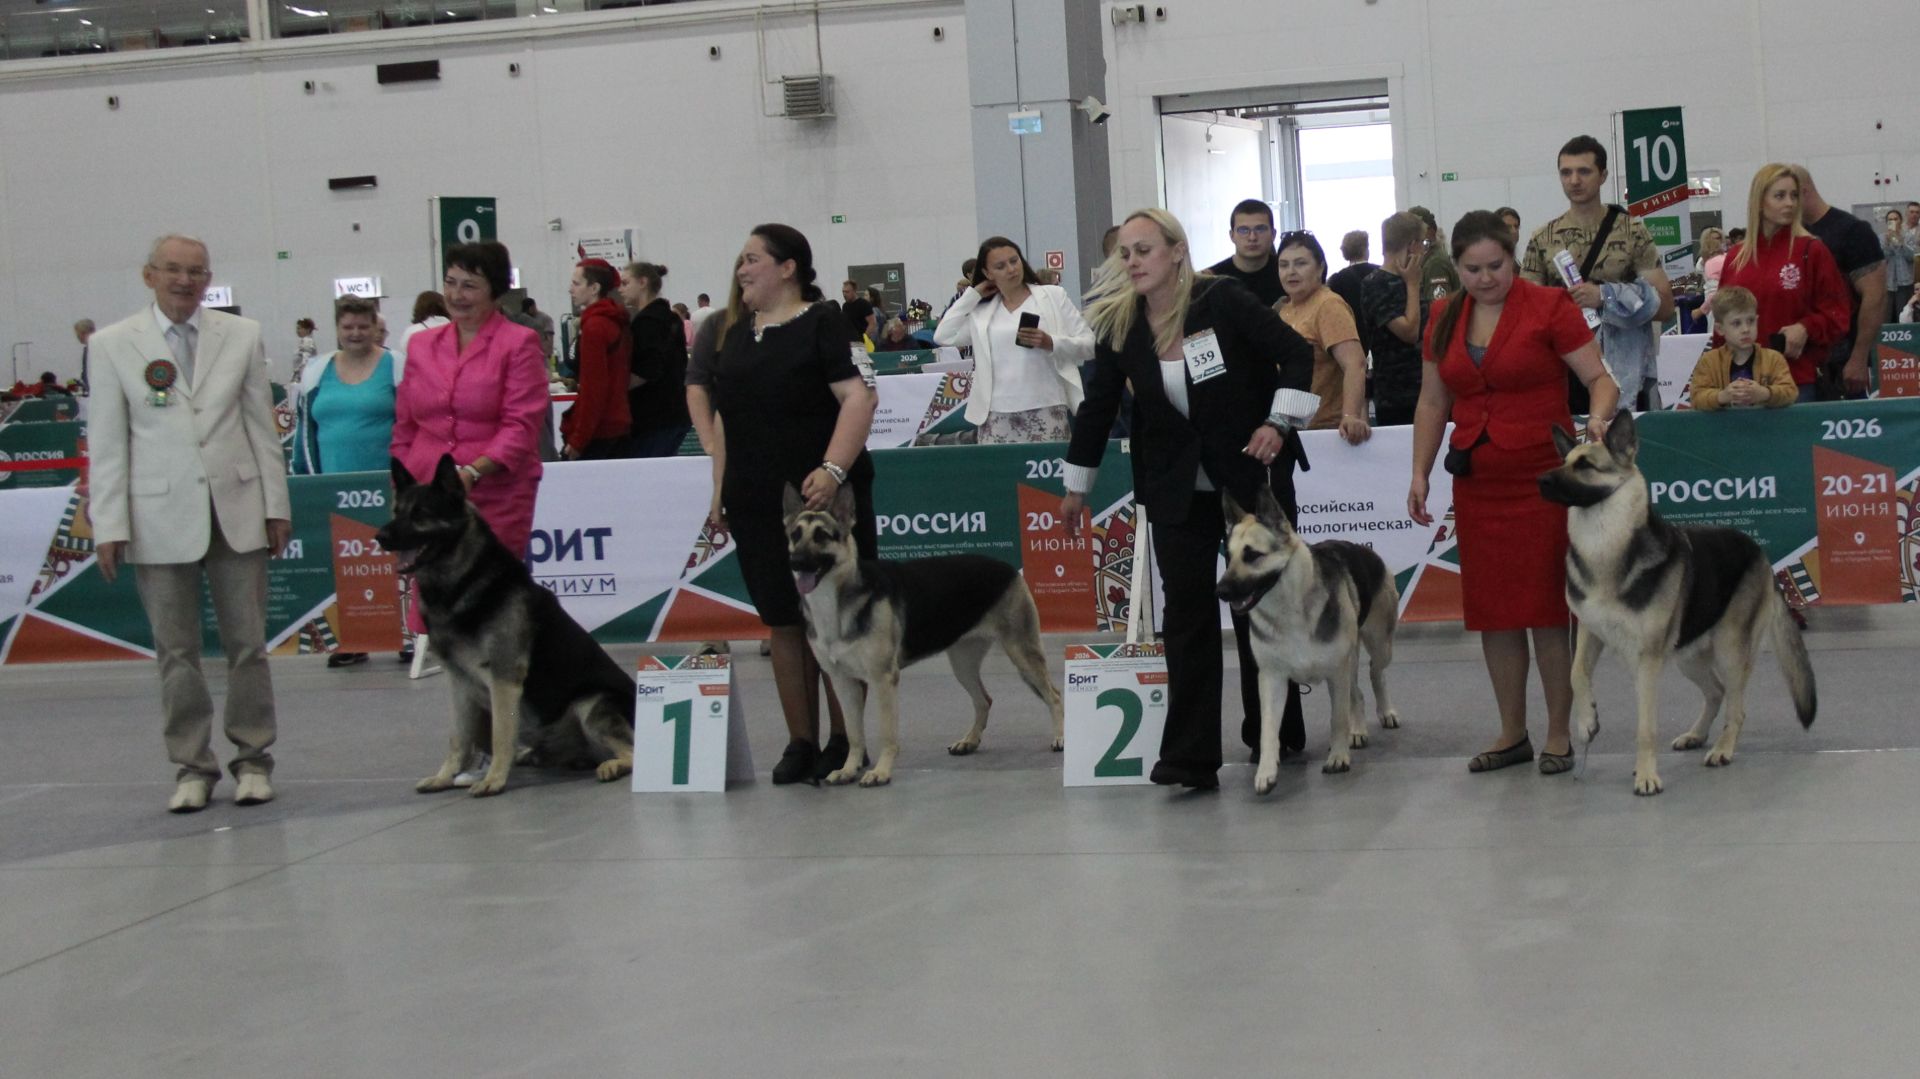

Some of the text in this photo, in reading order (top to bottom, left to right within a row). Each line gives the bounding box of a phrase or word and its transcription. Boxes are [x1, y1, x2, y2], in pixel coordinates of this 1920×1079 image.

[1633, 134, 1678, 182] 10
[1642, 190, 1682, 210] РИНГ
[347, 284, 364, 292] WC
[1881, 330, 1913, 342] 2026
[900, 354, 918, 362] 2026
[1192, 350, 1215, 367] 339
[1881, 358, 1915, 370] 20-21
[1821, 418, 1883, 440] 2026
[14, 450, 65, 462] РОССИЯ
[1651, 476, 1777, 504] РОССИЯ
[1822, 473, 1888, 496] 20-21
[336, 490, 385, 508] 2026
[1826, 502, 1890, 518] ИЮНЯ
[876, 511, 987, 535] РОССИЯ
[1031, 537, 1086, 551] ИЮНЯ
[343, 563, 393, 577] ИЮНЯ
[1068, 673, 1098, 686] Брит
[638, 684, 665, 696] Брит
[1094, 687, 1144, 778] 2
[662, 699, 693, 785] 1
